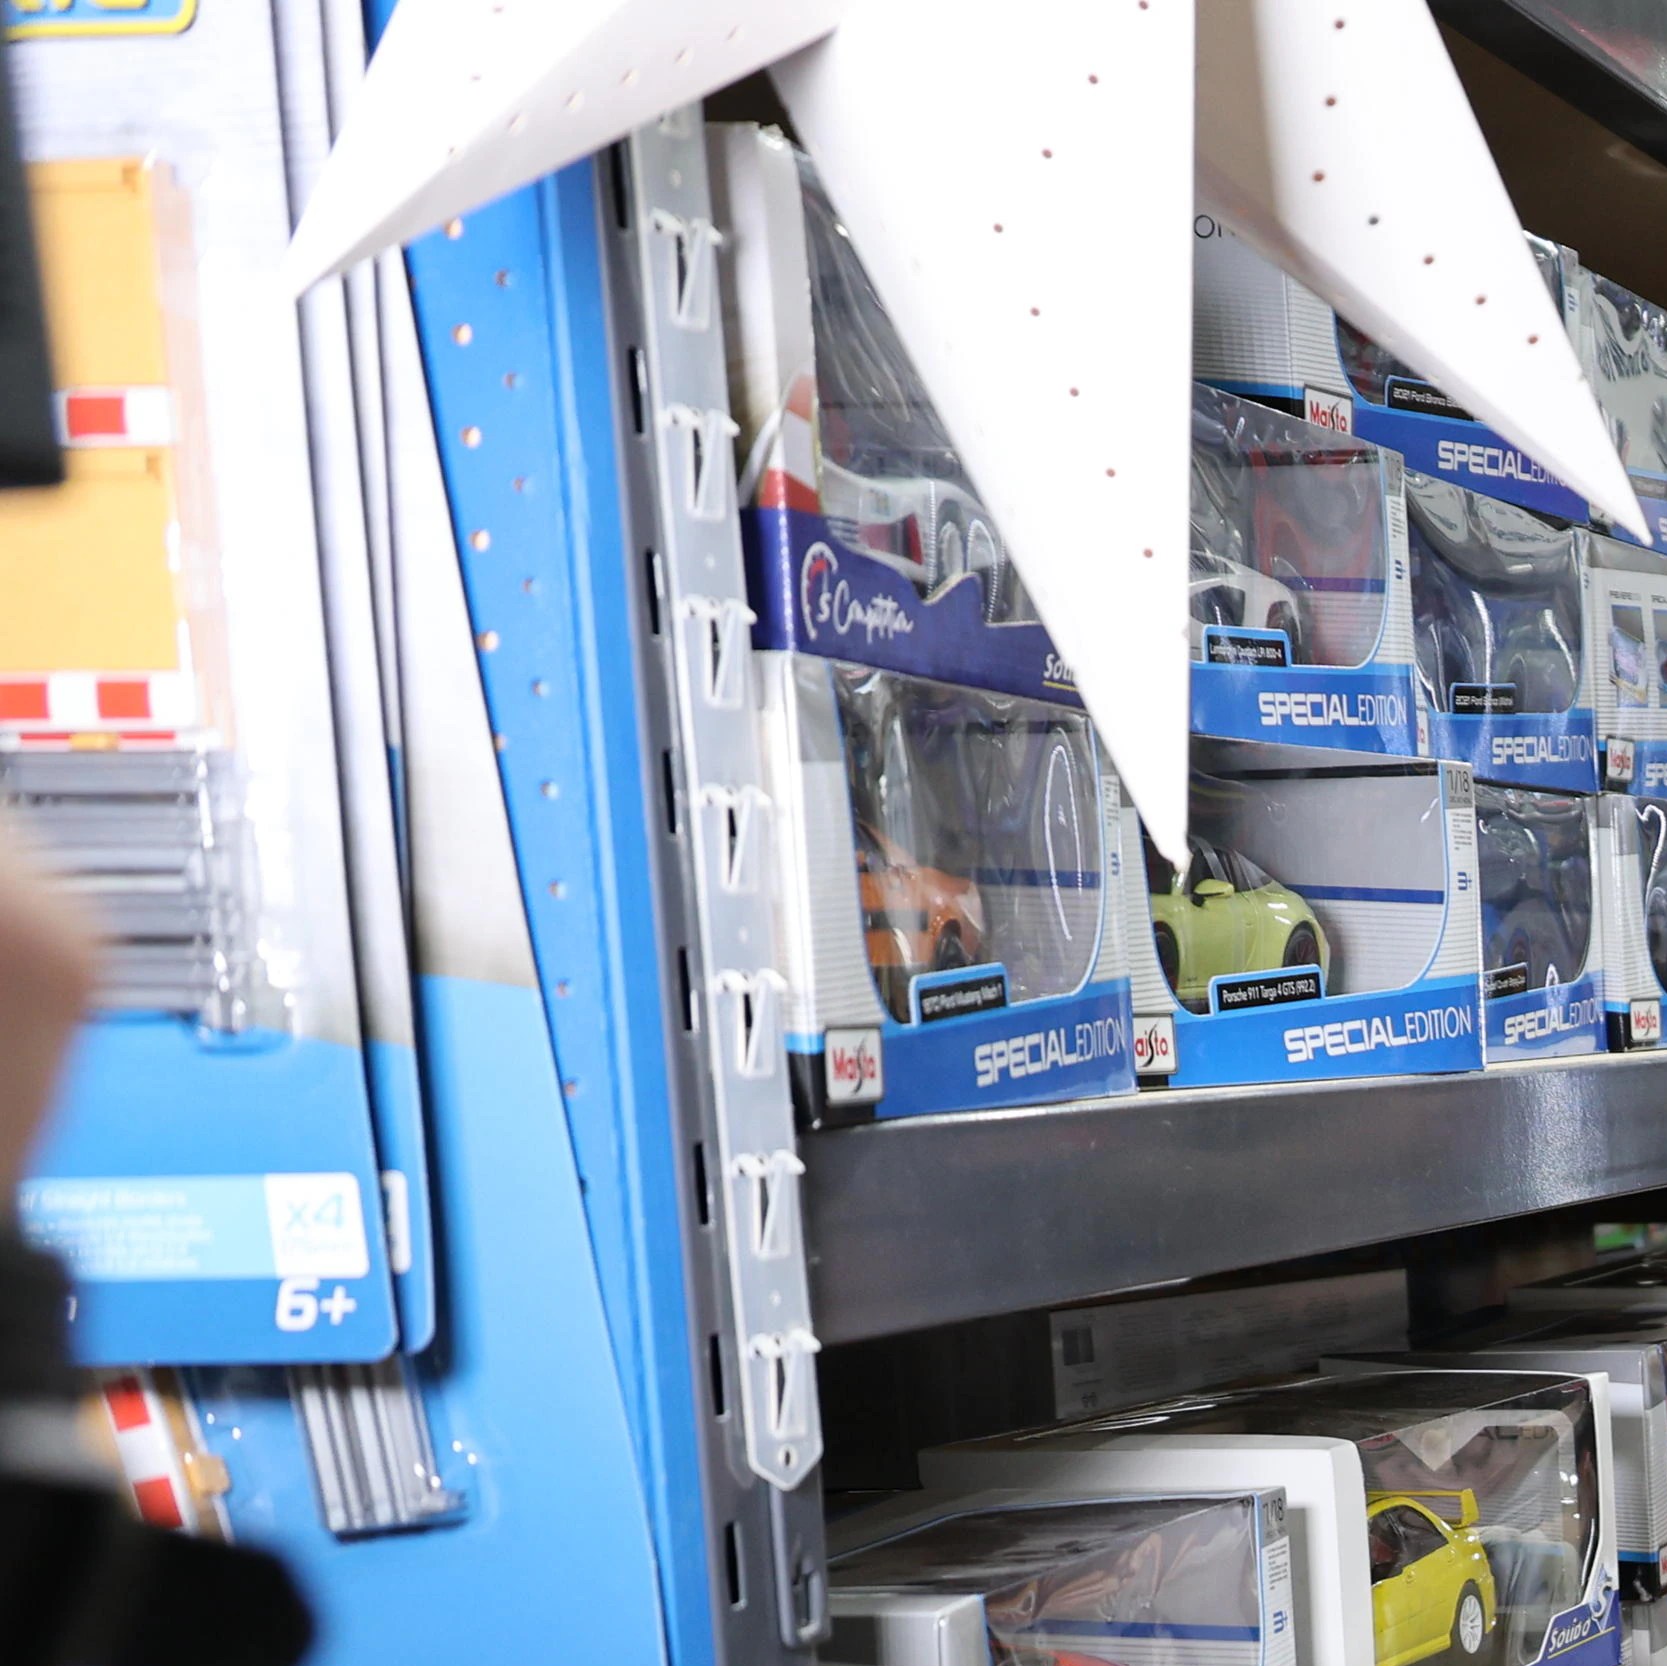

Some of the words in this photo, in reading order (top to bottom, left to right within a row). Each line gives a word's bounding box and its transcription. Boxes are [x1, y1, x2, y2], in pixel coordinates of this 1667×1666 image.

[1309, 400, 1348, 433] Maisto
[1222, 987, 1247, 1004] Porsche
[1247, 985, 1260, 1000] 911
[1261, 983, 1276, 1001] Targa
[1277, 983, 1283, 996] 4
[1283, 980, 1295, 996] GTS
[1135, 1030, 1168, 1062] aisto
[832, 1043, 877, 1086] Maisto
[275, 1277, 357, 1332] 6+
